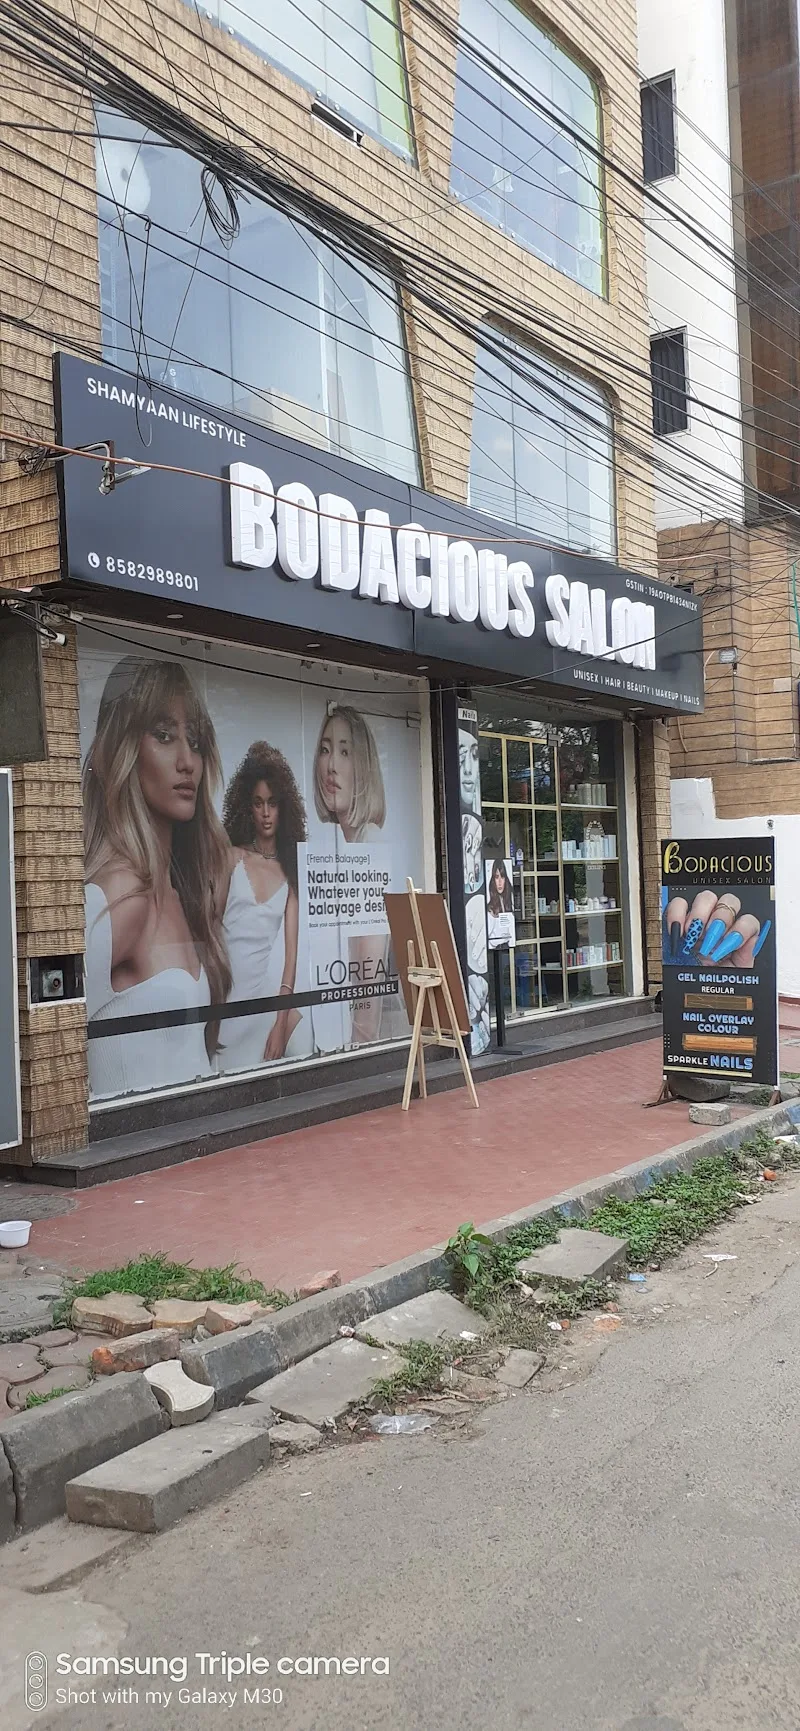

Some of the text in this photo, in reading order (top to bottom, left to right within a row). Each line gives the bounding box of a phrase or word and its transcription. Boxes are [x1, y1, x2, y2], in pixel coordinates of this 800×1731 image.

[86, 377, 247, 448] SHAMYAAN LIFESTYLE
[106, 556, 199, 592] 8582989801
[229, 461, 656, 671] BODACIOUS SALON
[625, 579, 644, 593] GSTIN
[573, 669, 599, 683] UNISEX
[605, 676, 621, 689] HAIR
[626, 681, 650, 695] BEAUTY
[656, 688, 679, 701] MAKEUP
[684, 695, 700, 706] NAILS
[306, 853, 371, 865] [French Balayage]
[664, 842, 773, 874] BODACIOUS
[307, 869, 392, 886] Natural looking.
[737, 876, 772, 884] SALON
[307, 886, 360, 900] Whatever
[308, 899, 387, 917] balayage desi
[316, 956, 398, 986] L'ORÉAL
[677, 973, 759, 985] GEL NAILPOLISH
[321, 983, 397, 1001] PROFESSIONNEL
[701, 986, 735, 994] REGULAR
[349, 1001, 371, 1011] PARIS
[682, 1012, 754, 1026] NAIL OVERLAY
[697, 1023, 739, 1034] COLOUR
[667, 1054, 753, 1070] SPARKLE NAILS
